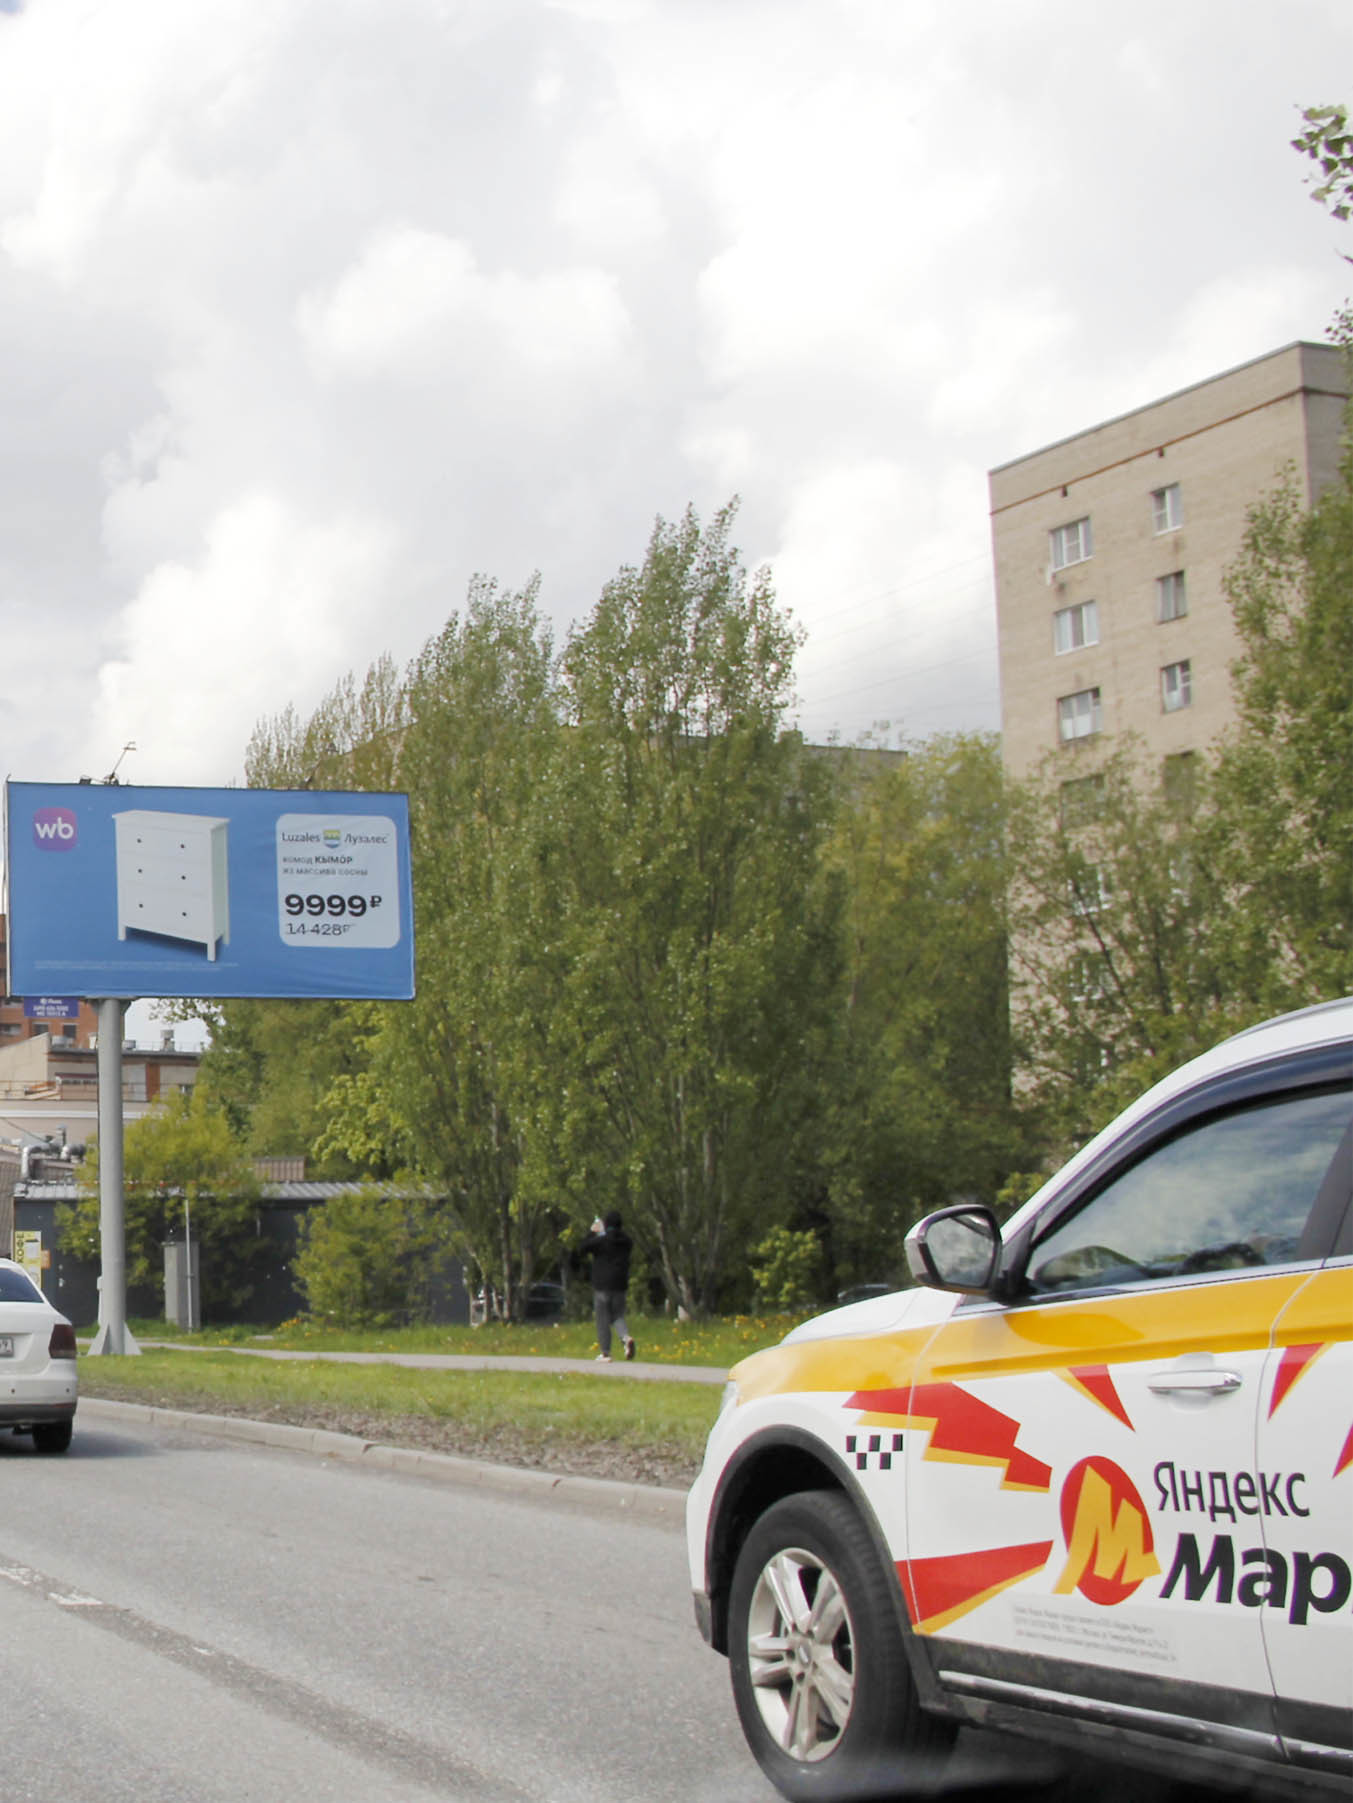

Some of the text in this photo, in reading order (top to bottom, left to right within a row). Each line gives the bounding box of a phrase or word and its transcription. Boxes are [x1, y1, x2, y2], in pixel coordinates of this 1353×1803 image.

[35, 816, 74, 839] wb
[281, 832, 321, 843] Luzales
[1153, 1461, 1310, 1523] Яндекс
[1159, 1532, 1353, 1626] Мар
